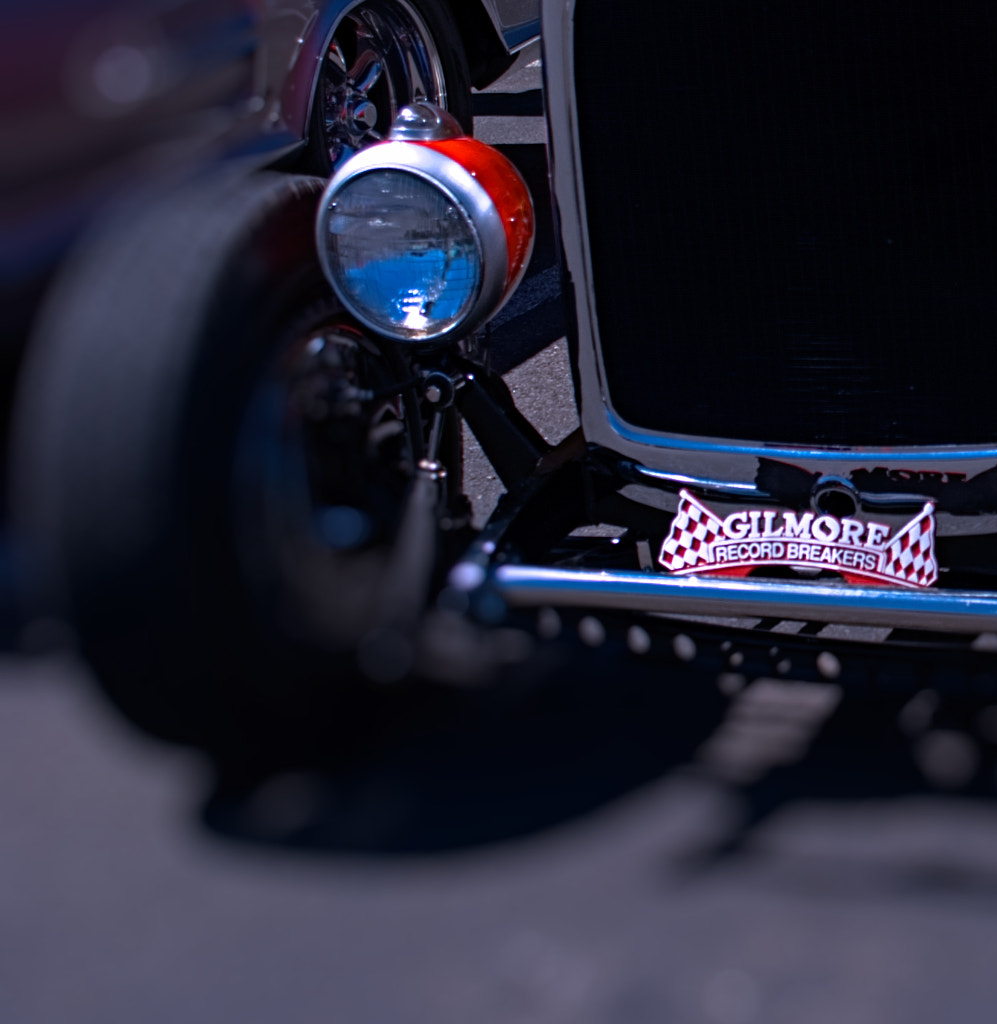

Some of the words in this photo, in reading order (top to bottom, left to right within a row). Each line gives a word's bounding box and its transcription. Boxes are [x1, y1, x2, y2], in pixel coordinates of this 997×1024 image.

[722, 510, 890, 549] GILMORE
[714, 541, 785, 563] RECORD
[786, 542, 876, 570] BREAKERS
